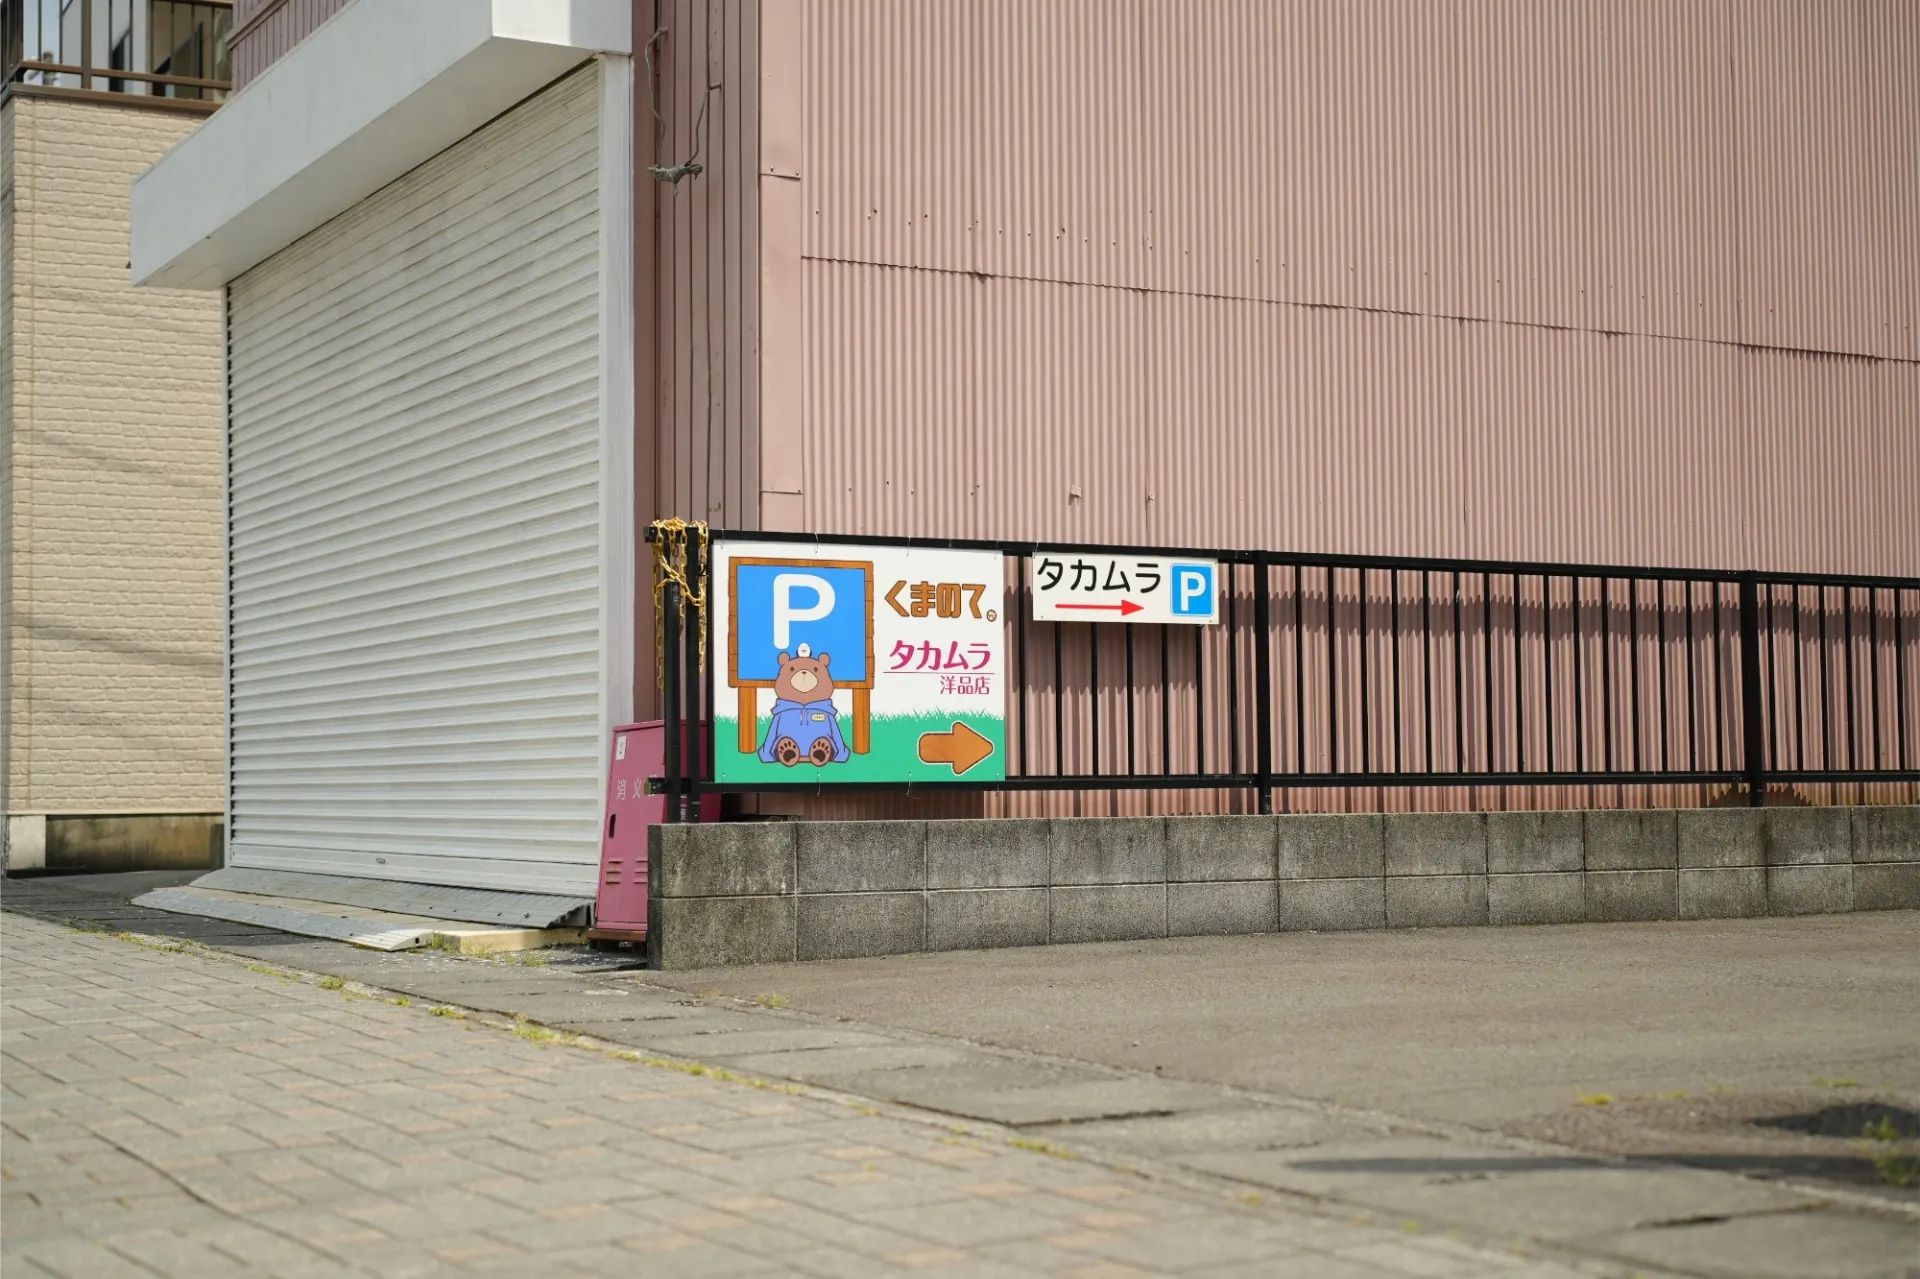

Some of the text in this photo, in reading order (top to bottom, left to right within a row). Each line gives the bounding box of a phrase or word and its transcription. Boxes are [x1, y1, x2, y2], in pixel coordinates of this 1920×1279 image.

[1037, 557, 1161, 594] タカムラ
[1180, 571, 1206, 612] P
[773, 573, 836, 650] P
[889, 640, 991, 670] タカムラ
[940, 676, 991, 694] 洋品店
[616, 774, 659, 801] 消火
